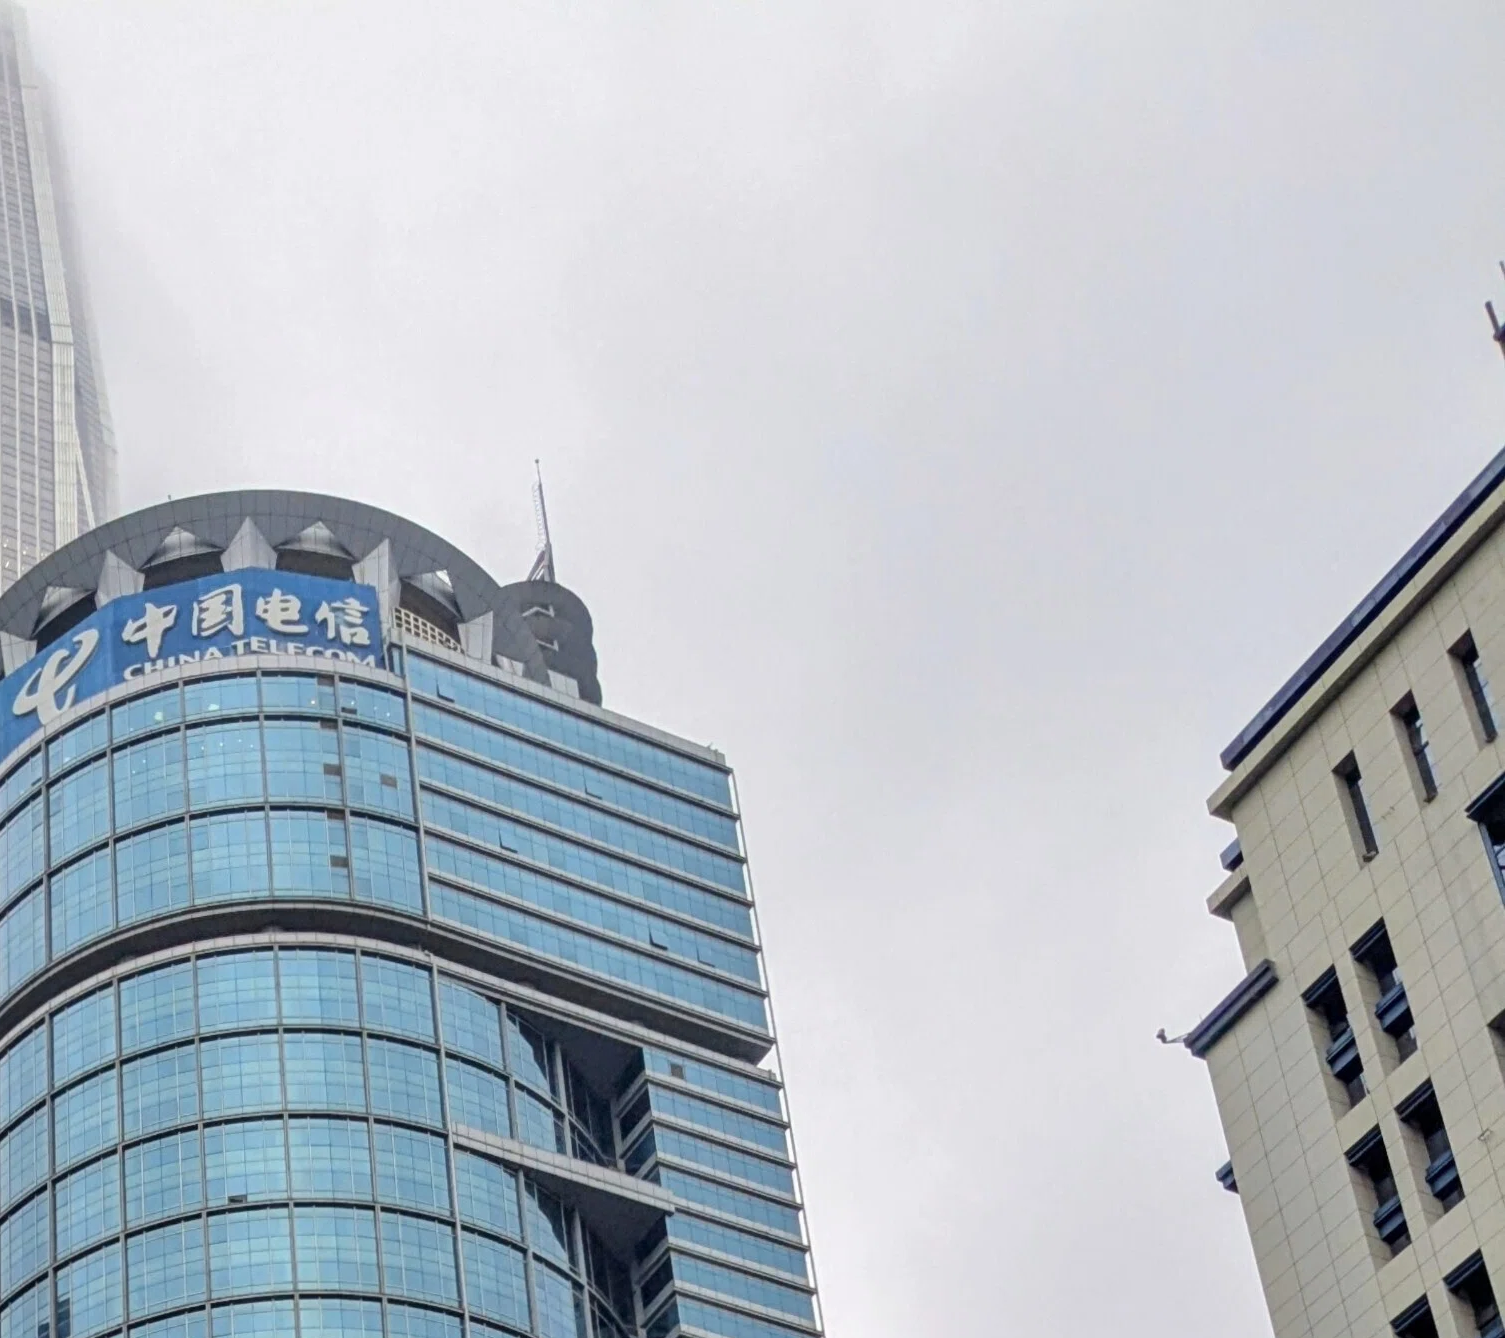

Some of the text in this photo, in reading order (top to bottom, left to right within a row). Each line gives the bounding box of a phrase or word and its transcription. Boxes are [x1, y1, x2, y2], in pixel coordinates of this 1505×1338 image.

[121, 583, 372, 660] 中国电信
[123, 636, 375, 681] CHINA TELECOM
